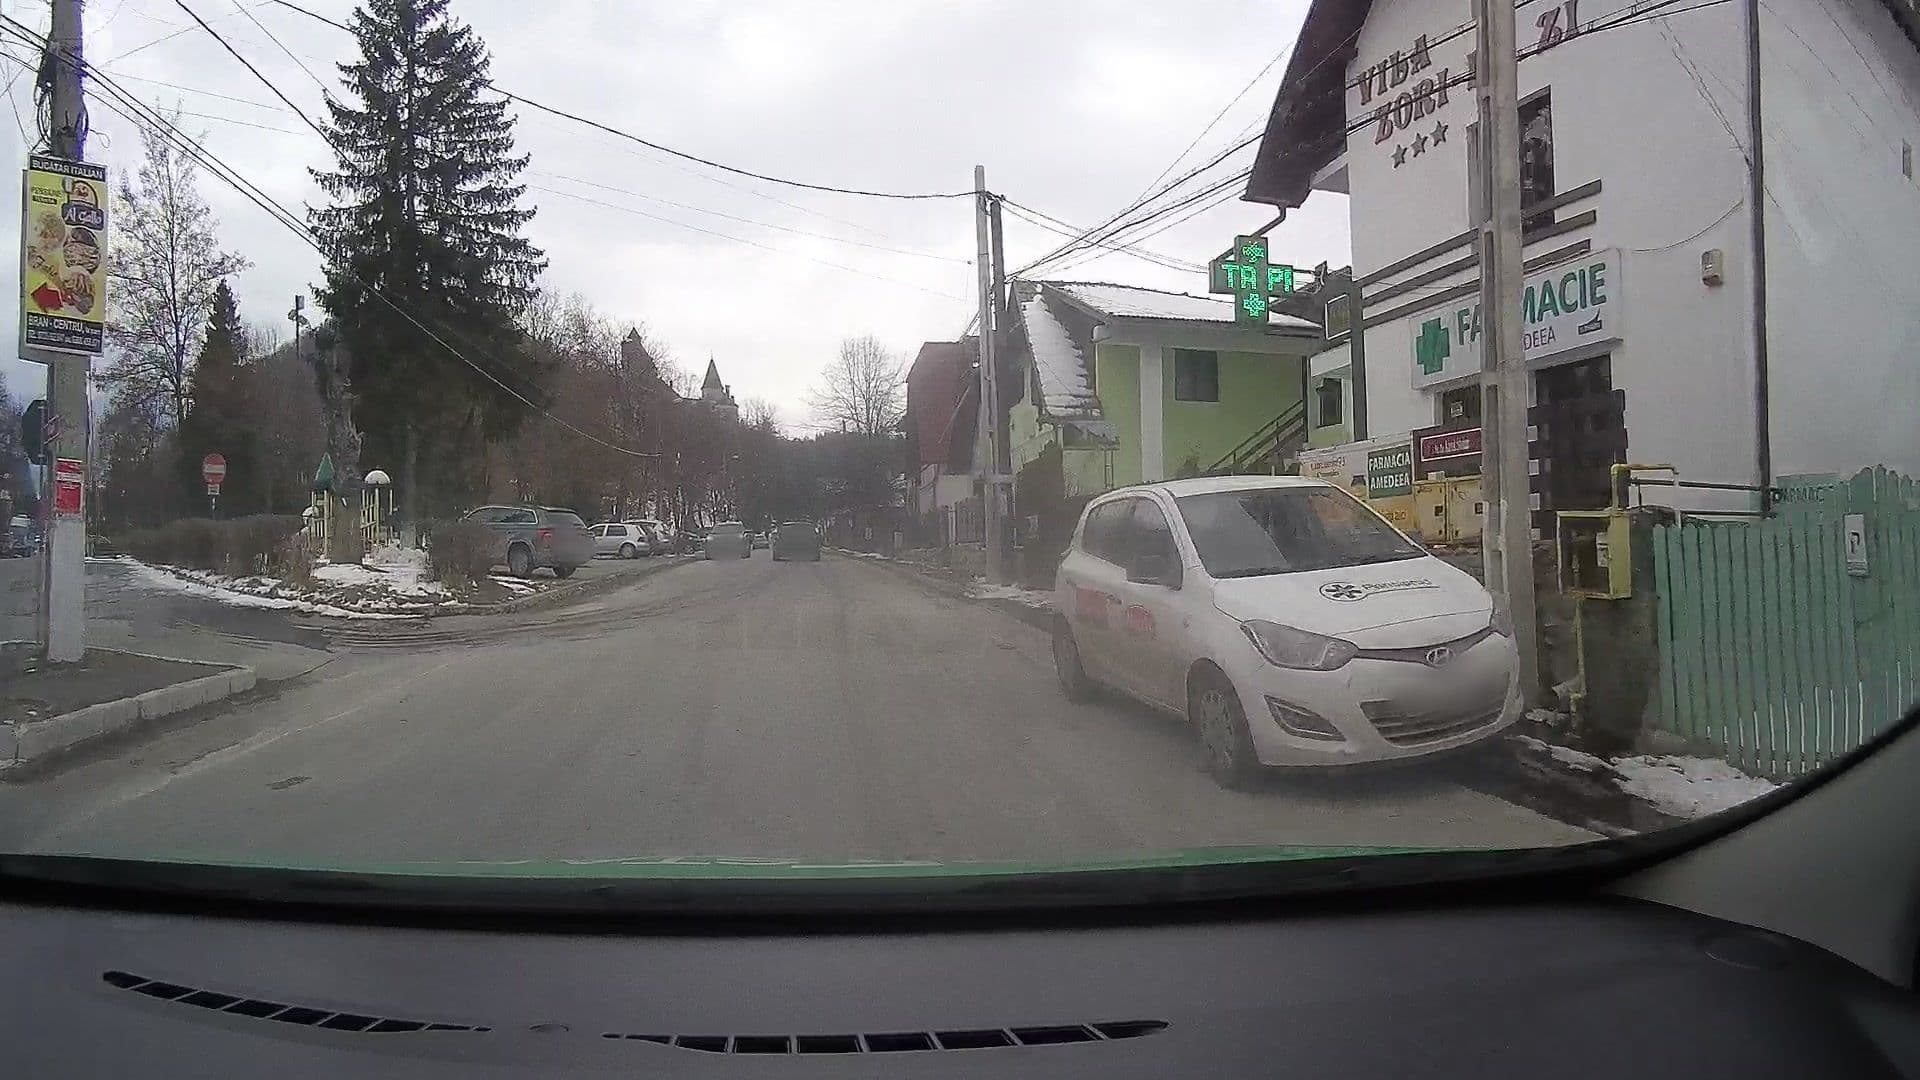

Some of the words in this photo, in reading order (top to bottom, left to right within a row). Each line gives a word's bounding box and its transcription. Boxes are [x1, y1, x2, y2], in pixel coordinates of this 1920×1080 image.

[1359, 34, 1431, 106] VILA
[1375, 68, 1449, 145] ZORI
[71, 165, 103, 179] ITALIAN
[65, 207, 76, 222] Al
[1457, 262, 1607, 346] FAMACIE
[1368, 451, 1411, 472] FARMACIA
[1370, 472, 1410, 490] AMEDEEA
